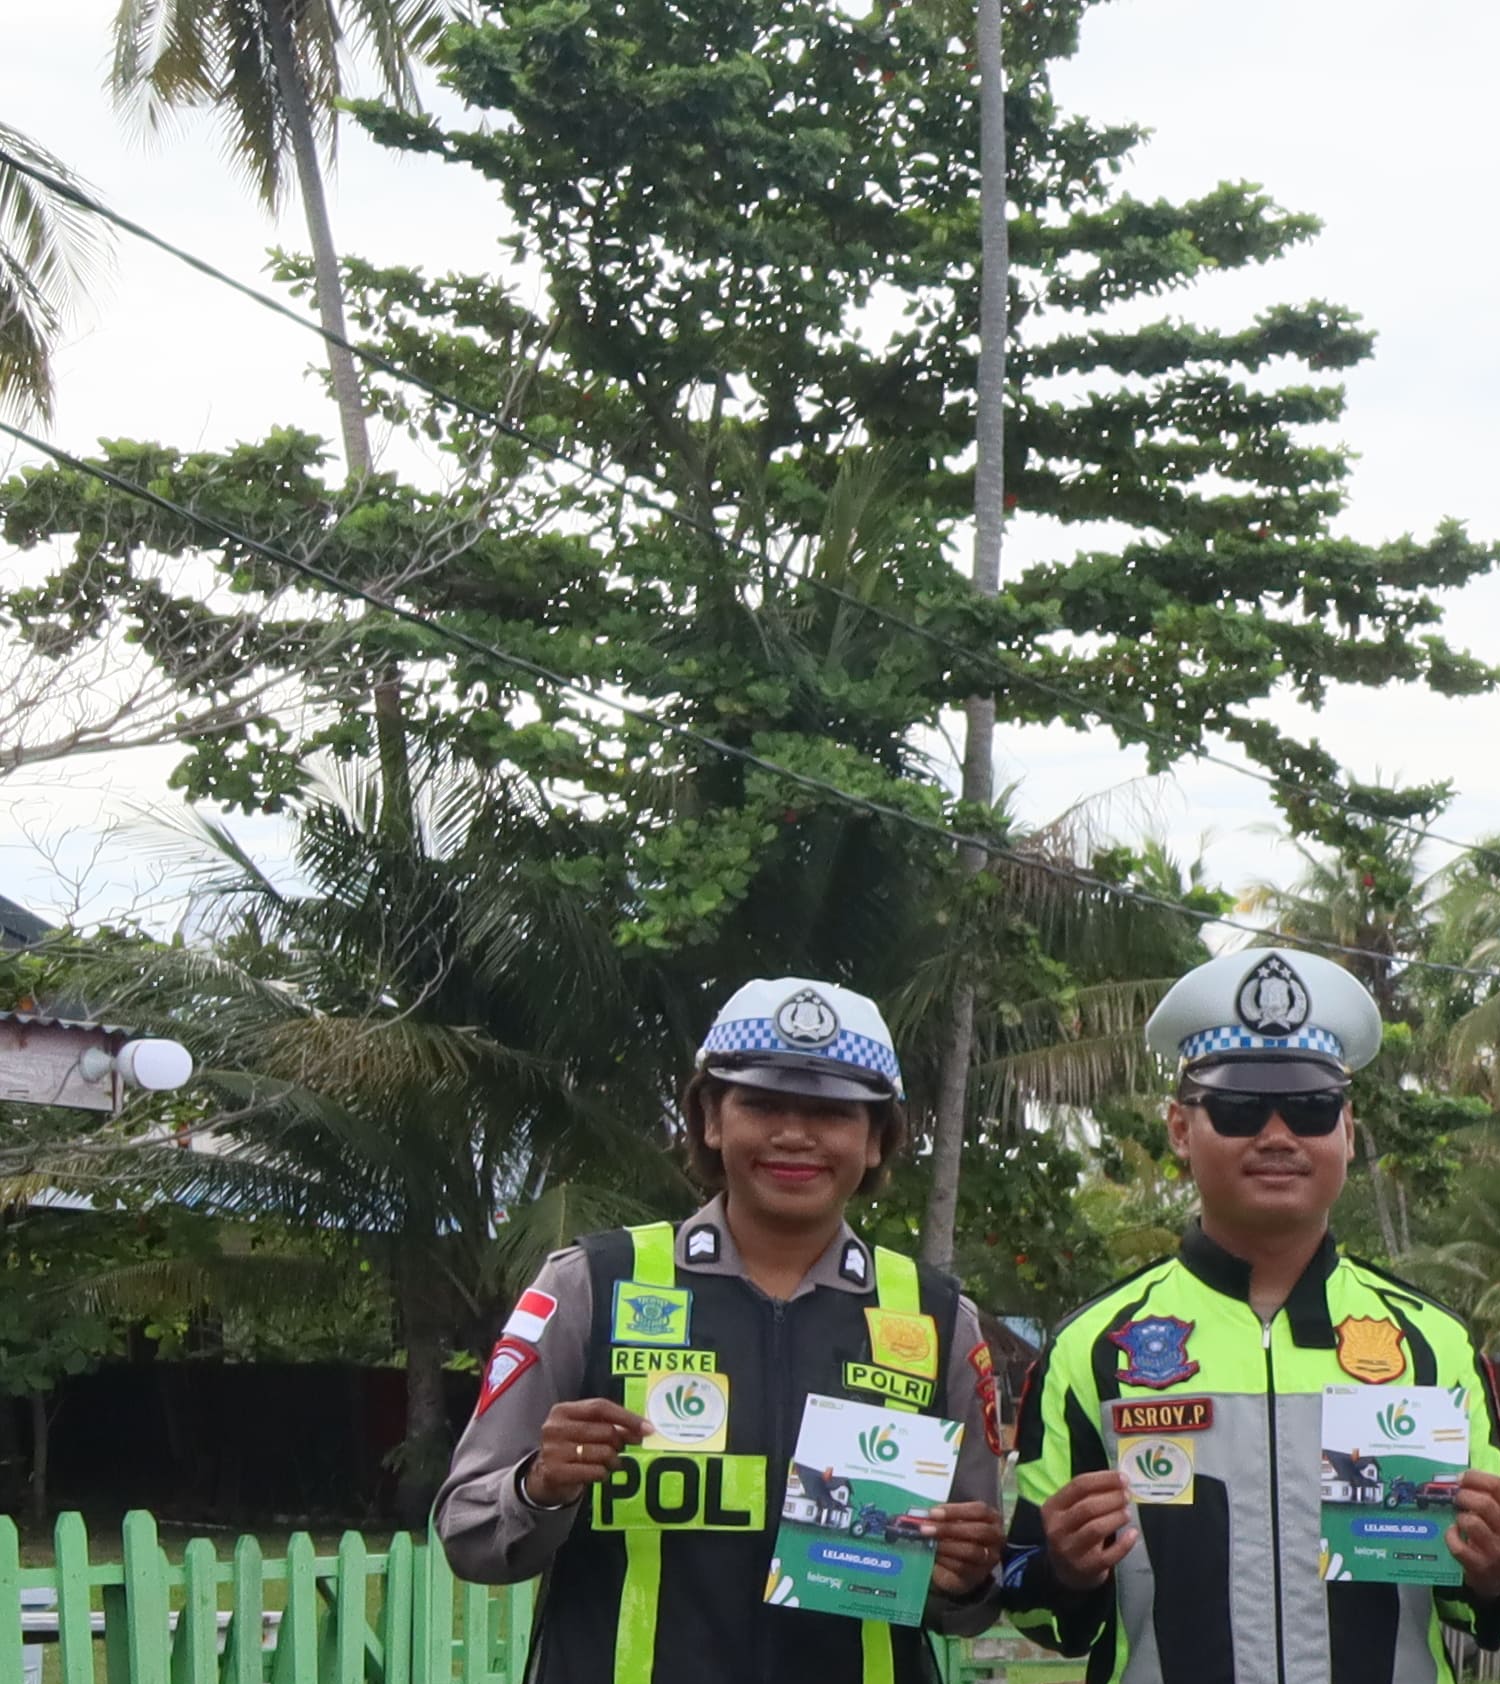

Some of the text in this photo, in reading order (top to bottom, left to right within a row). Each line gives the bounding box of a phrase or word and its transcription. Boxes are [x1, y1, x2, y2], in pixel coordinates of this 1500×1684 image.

[616, 1351, 714, 1373] RENSKE
[852, 1365, 930, 1402] POLRI
[600, 1456, 752, 1526] POL
